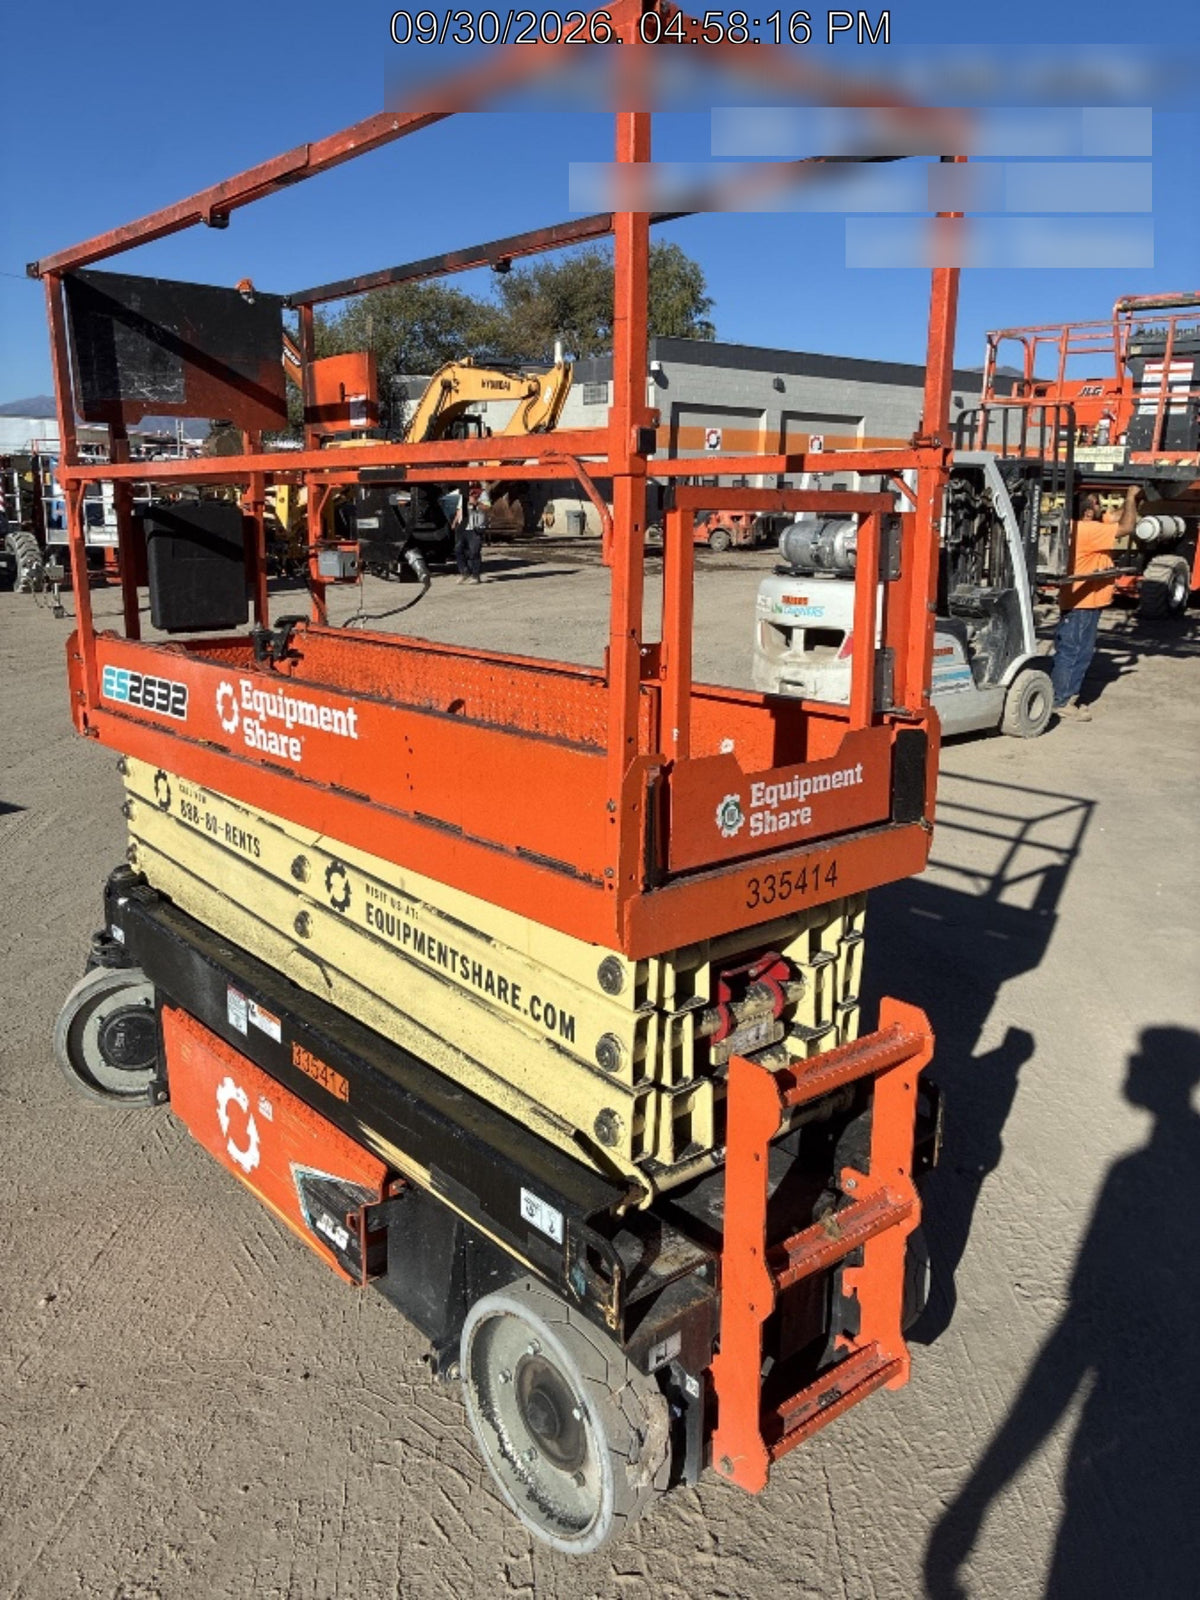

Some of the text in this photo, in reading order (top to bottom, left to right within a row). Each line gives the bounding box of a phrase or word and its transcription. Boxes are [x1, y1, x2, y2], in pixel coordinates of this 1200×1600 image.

[103, 667, 187, 719] ES2632
[240, 679, 358, 739] Equipment
[243, 718, 303, 762] Share
[750, 763, 864, 809] Equipment
[750, 806, 812, 837] Share
[746, 860, 837, 910] 335414
[365, 901, 576, 1043] EQUIPMENTSHARE.COM
